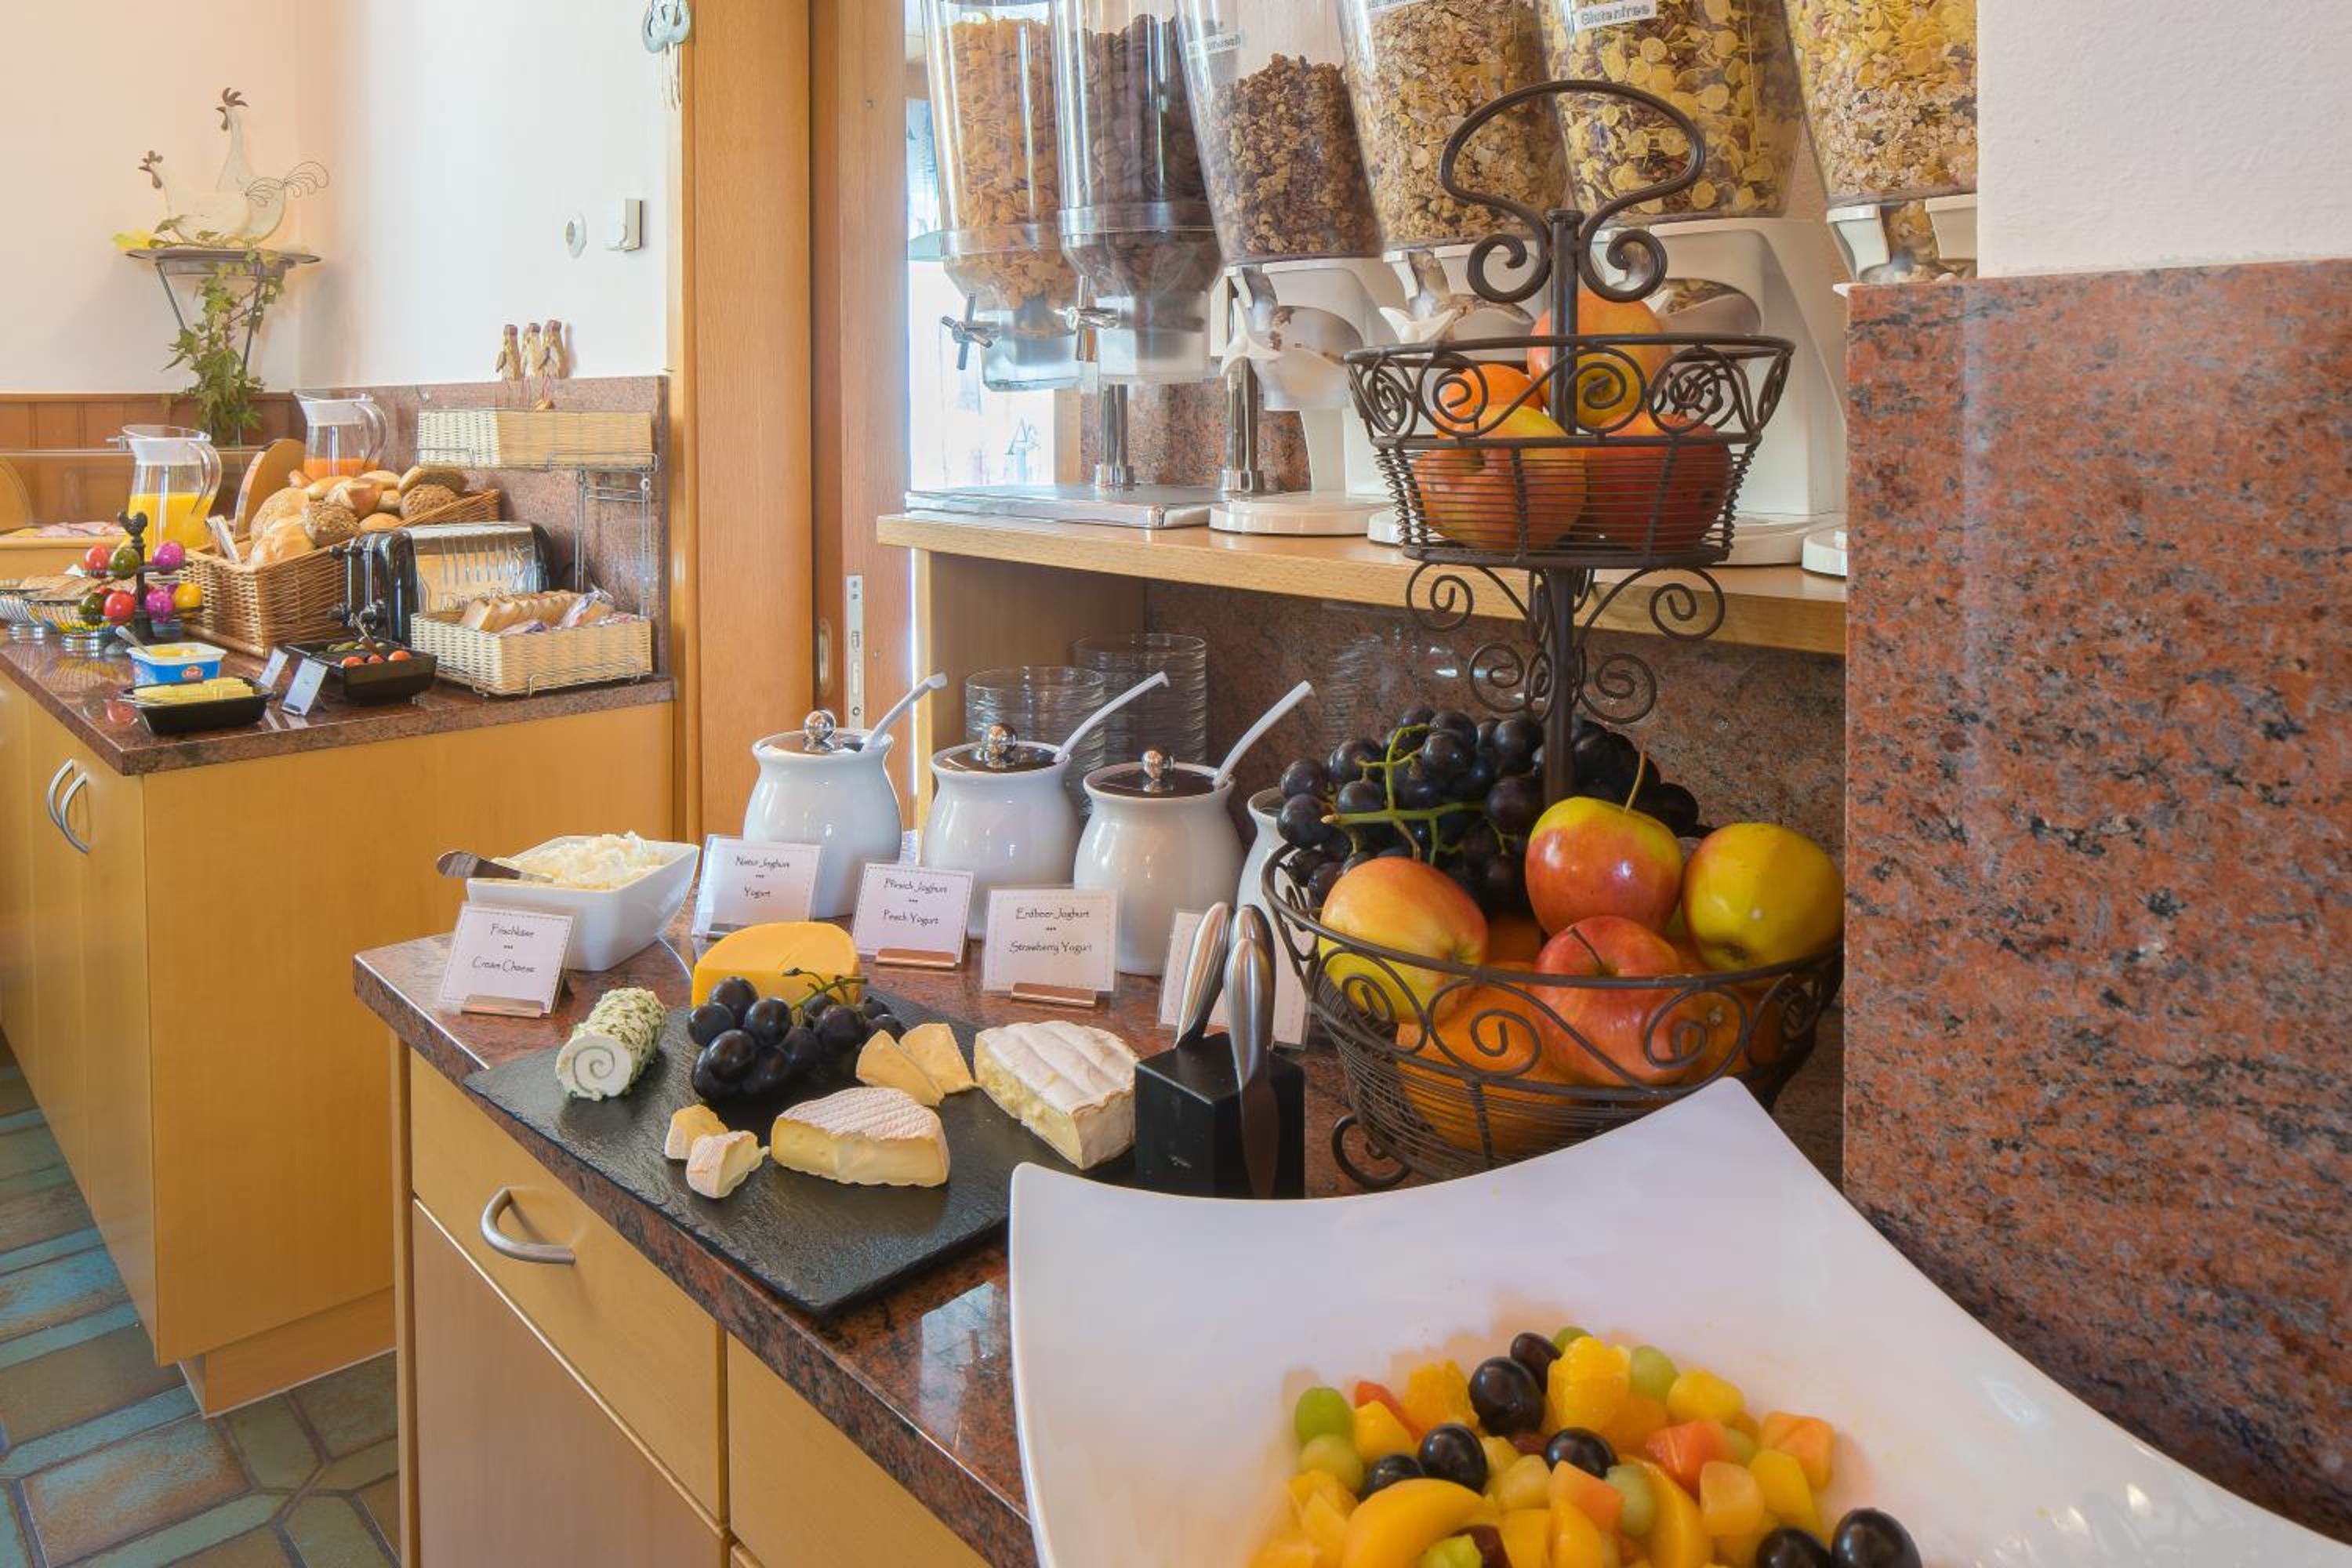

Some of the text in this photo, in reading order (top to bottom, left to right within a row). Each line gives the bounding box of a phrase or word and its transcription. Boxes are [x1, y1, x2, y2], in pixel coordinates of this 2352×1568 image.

[744, 887, 771, 898] Yogurt
[884, 909, 939, 926] Peach Yogurt
[1016, 907, 1090, 920] Erdbeer Joghurt
[1009, 941, 1092, 956] Strawberry Yogurt
[472, 956, 502, 970] Cream
